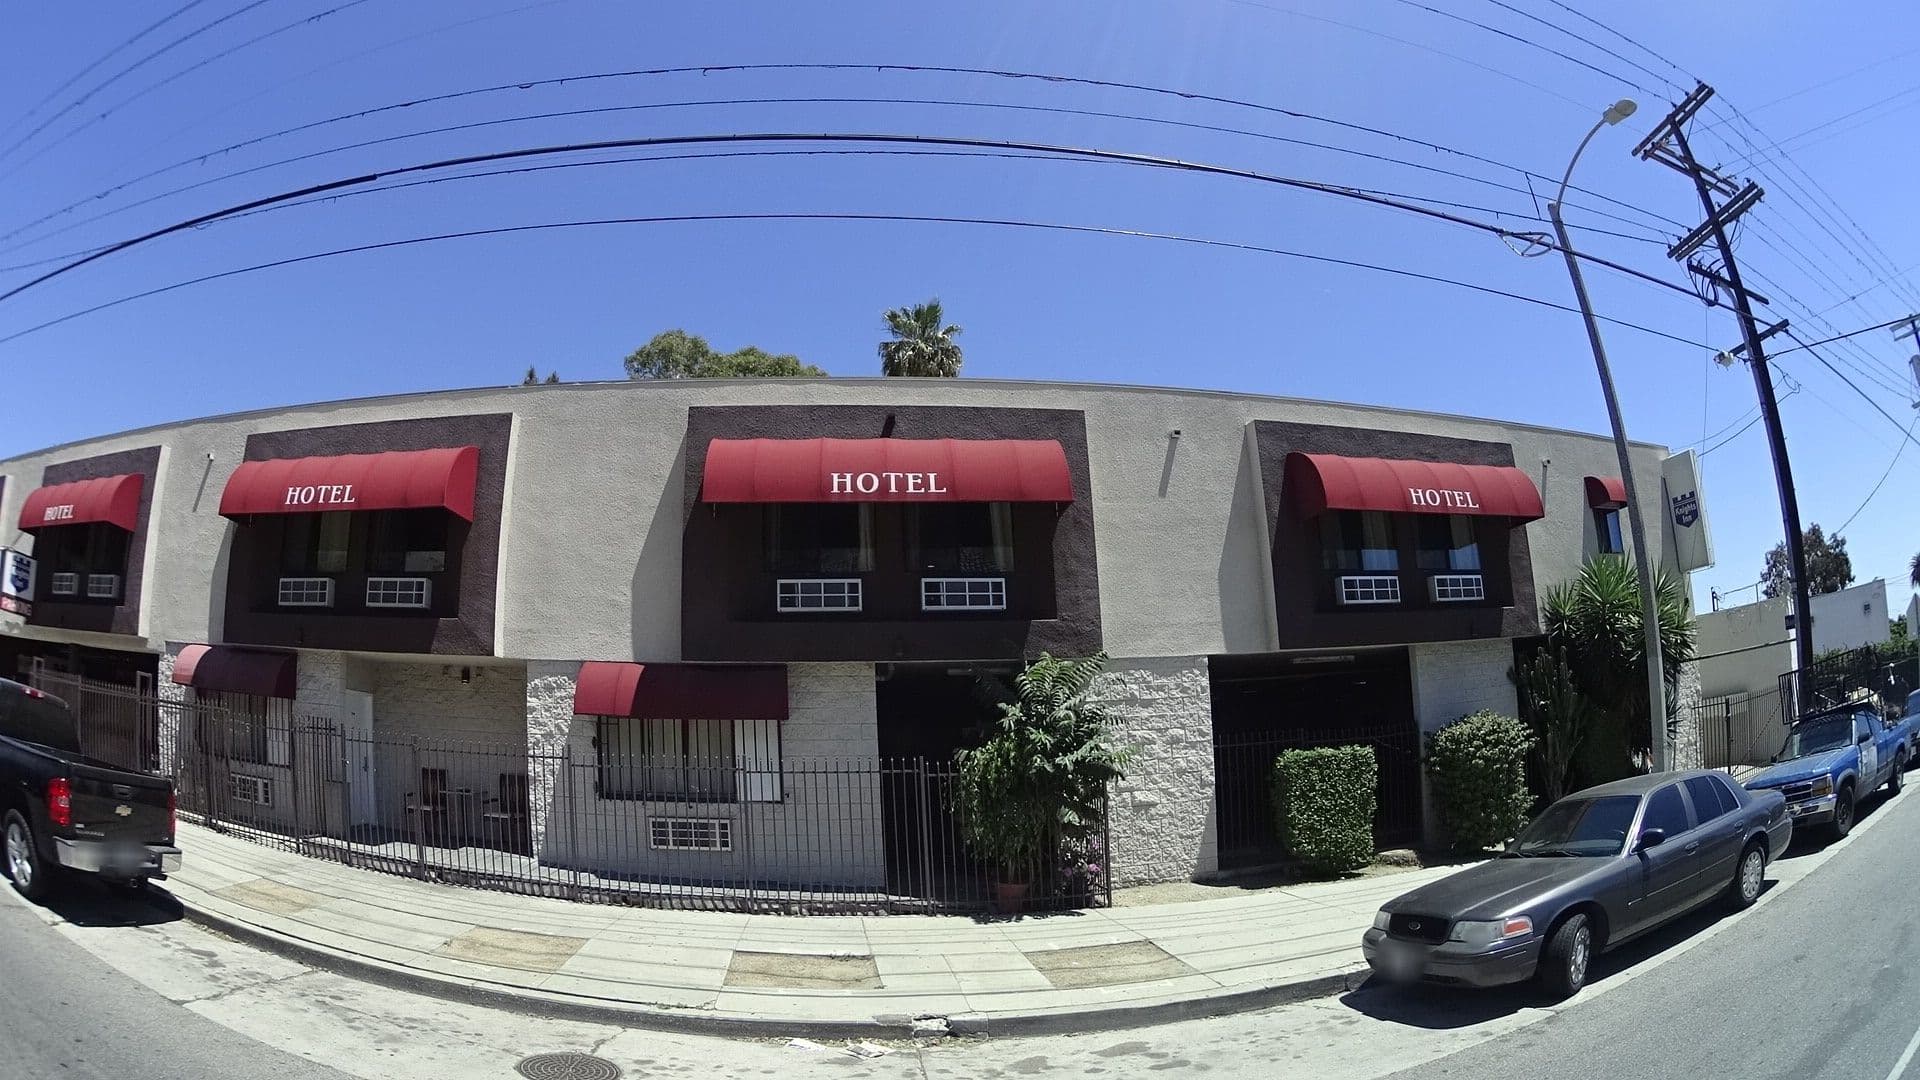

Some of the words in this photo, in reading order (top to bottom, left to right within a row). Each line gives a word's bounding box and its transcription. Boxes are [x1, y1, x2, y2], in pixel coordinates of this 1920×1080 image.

[830, 473, 946, 493] HOTEL
[284, 485, 355, 504] HOTEL
[1408, 488, 1479, 508] HOTEL
[43, 504, 74, 521] HOTEL
[1675, 503, 1697, 516] Knights
